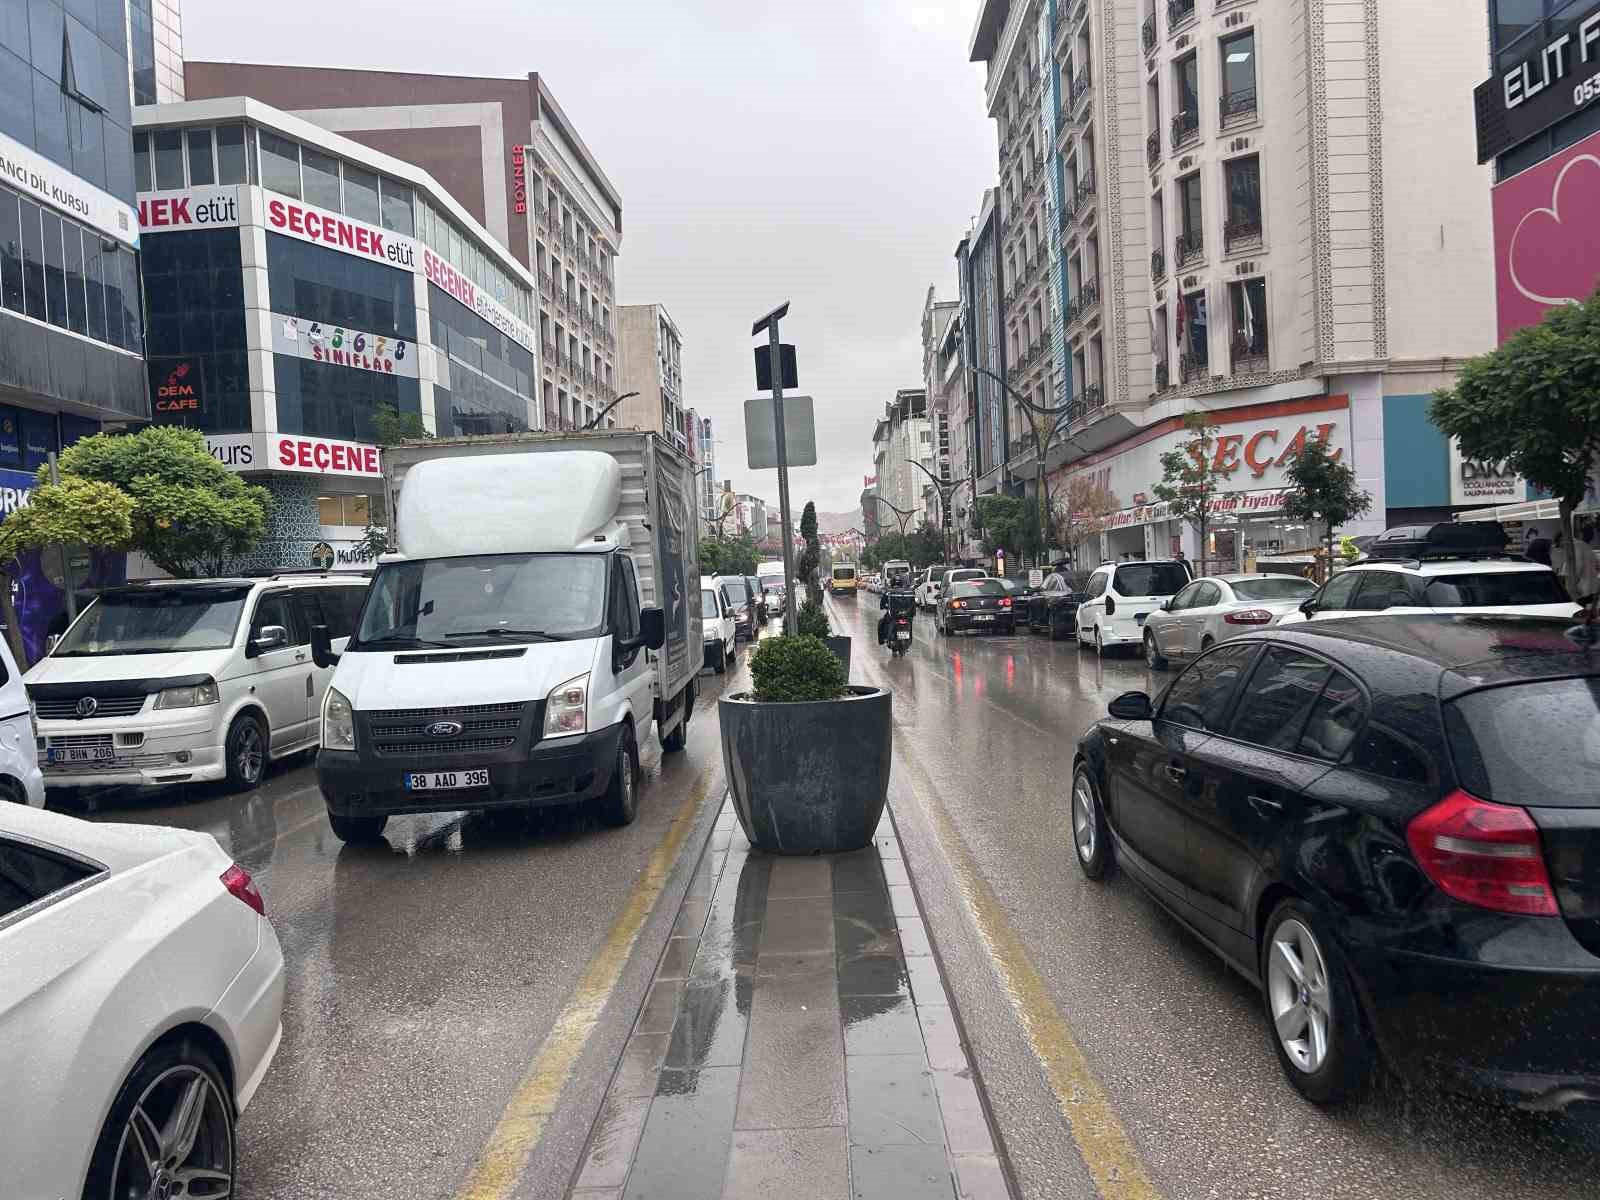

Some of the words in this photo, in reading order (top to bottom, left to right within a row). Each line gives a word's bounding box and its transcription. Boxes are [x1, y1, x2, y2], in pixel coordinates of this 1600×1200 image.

[1504, 33, 1570, 109] ELIT
[512, 145, 526, 213] BOYNER
[30, 174, 49, 197] DİL
[52, 184, 89, 216] KURSU
[195, 196, 236, 223] etüt
[269, 200, 385, 258] SEÇENEK
[387, 242, 415, 267] etüt
[353, 333, 366, 352] 6
[394, 341, 406, 360] 8
[156, 399, 199, 411] CAFE
[158, 386, 193, 397] DEM
[279, 439, 383, 472] SEÇENE
[411, 775, 426, 788] 38
[435, 773, 457, 787] AAD
[465, 771, 488, 785] 396
